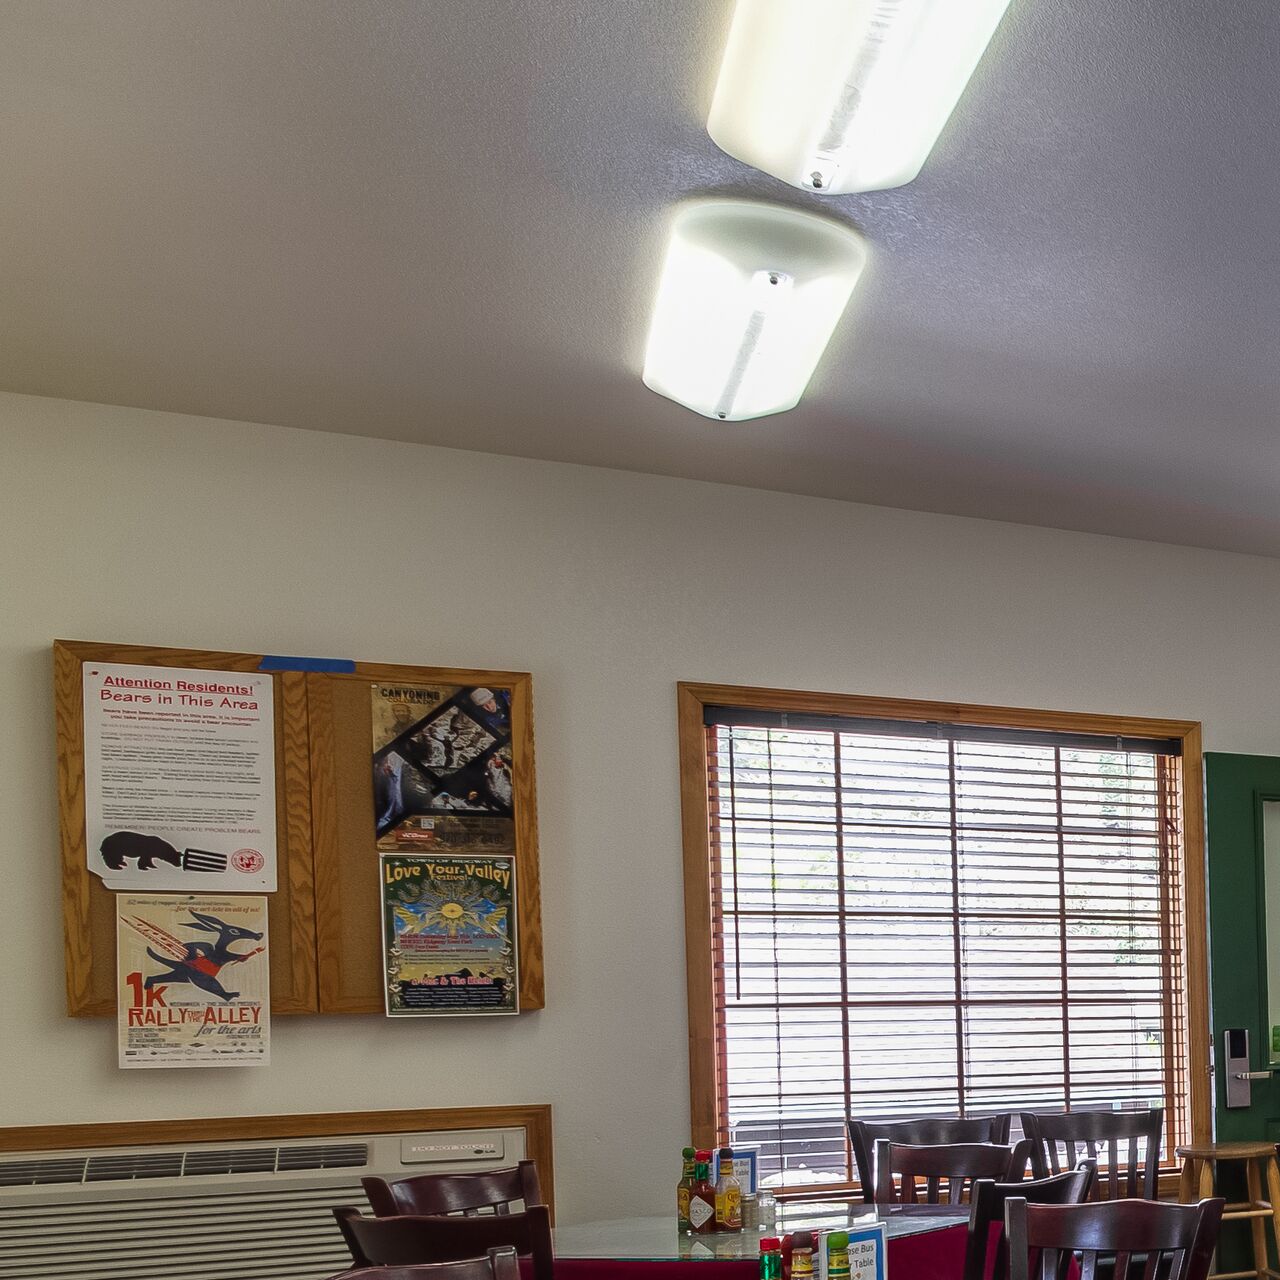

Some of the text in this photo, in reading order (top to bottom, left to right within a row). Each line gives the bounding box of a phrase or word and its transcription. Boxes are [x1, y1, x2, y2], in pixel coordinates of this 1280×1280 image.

[104, 675, 253, 695] Attention Residents!
[381, 688, 440, 701] CANYONING
[100, 690, 258, 710] Bears in This Area
[385, 863, 511, 890] Love Your Valley
[128, 1008, 189, 1027] RALLY
[203, 1006, 262, 1025] ALLEY
[193, 1025, 217, 1038] for
[217, 1025, 237, 1035] the
[237, 1025, 262, 1035] arts
[861, 1244, 874, 1253] Bus
[855, 1258, 874, 1269] Table
